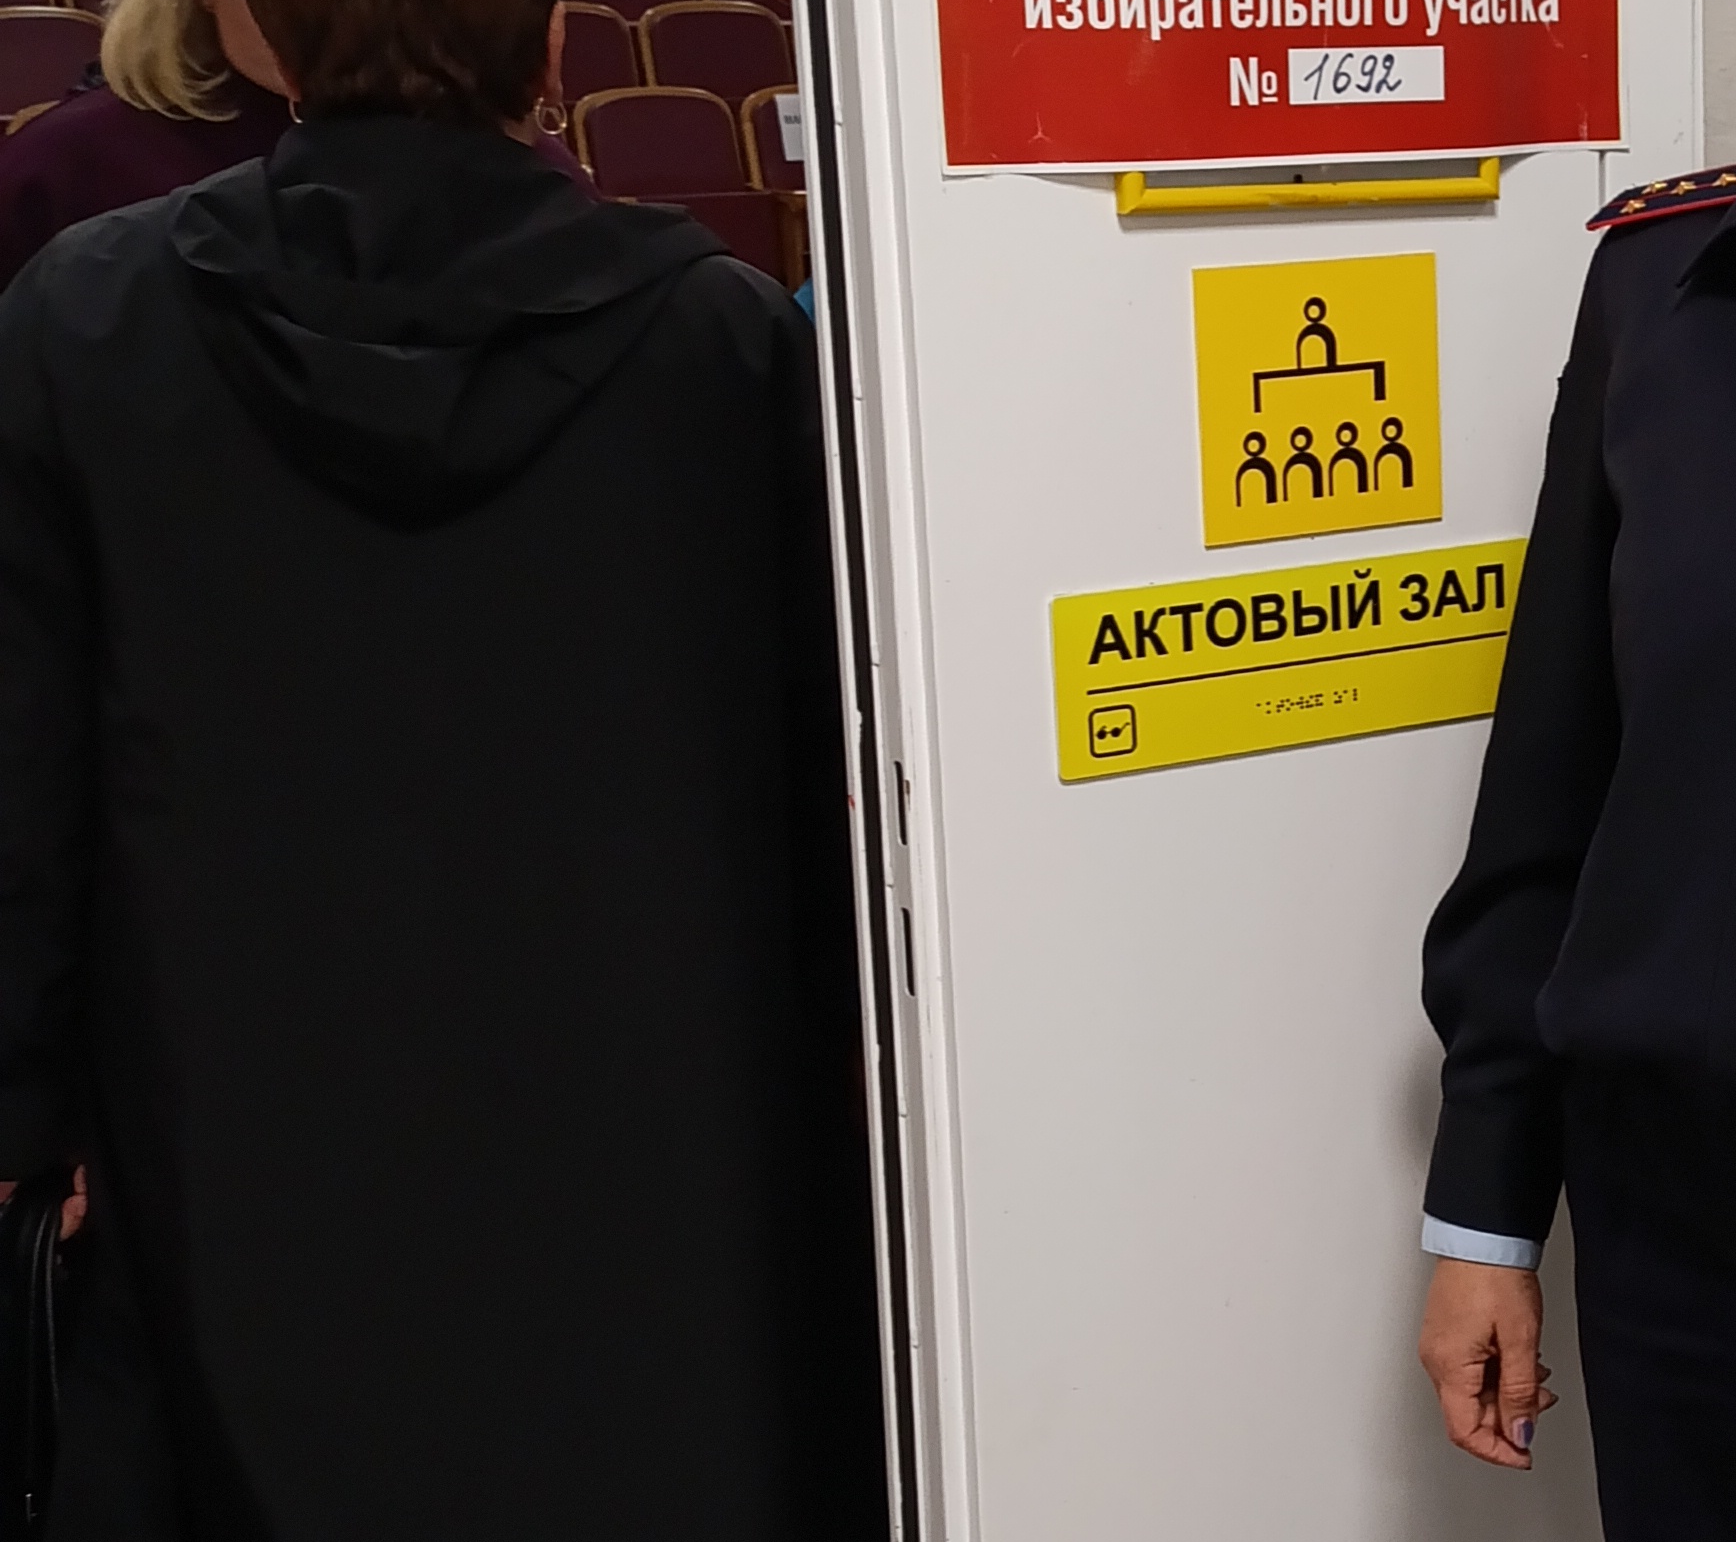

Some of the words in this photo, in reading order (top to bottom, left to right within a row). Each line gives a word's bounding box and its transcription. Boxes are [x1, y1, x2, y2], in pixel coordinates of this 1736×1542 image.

[1229, 56, 1279, 106] №
[1303, 52, 1403, 102] 1692
[1087, 567, 1382, 665] АКТОВЫЙ
[1399, 562, 1506, 623] ЗАЛ
